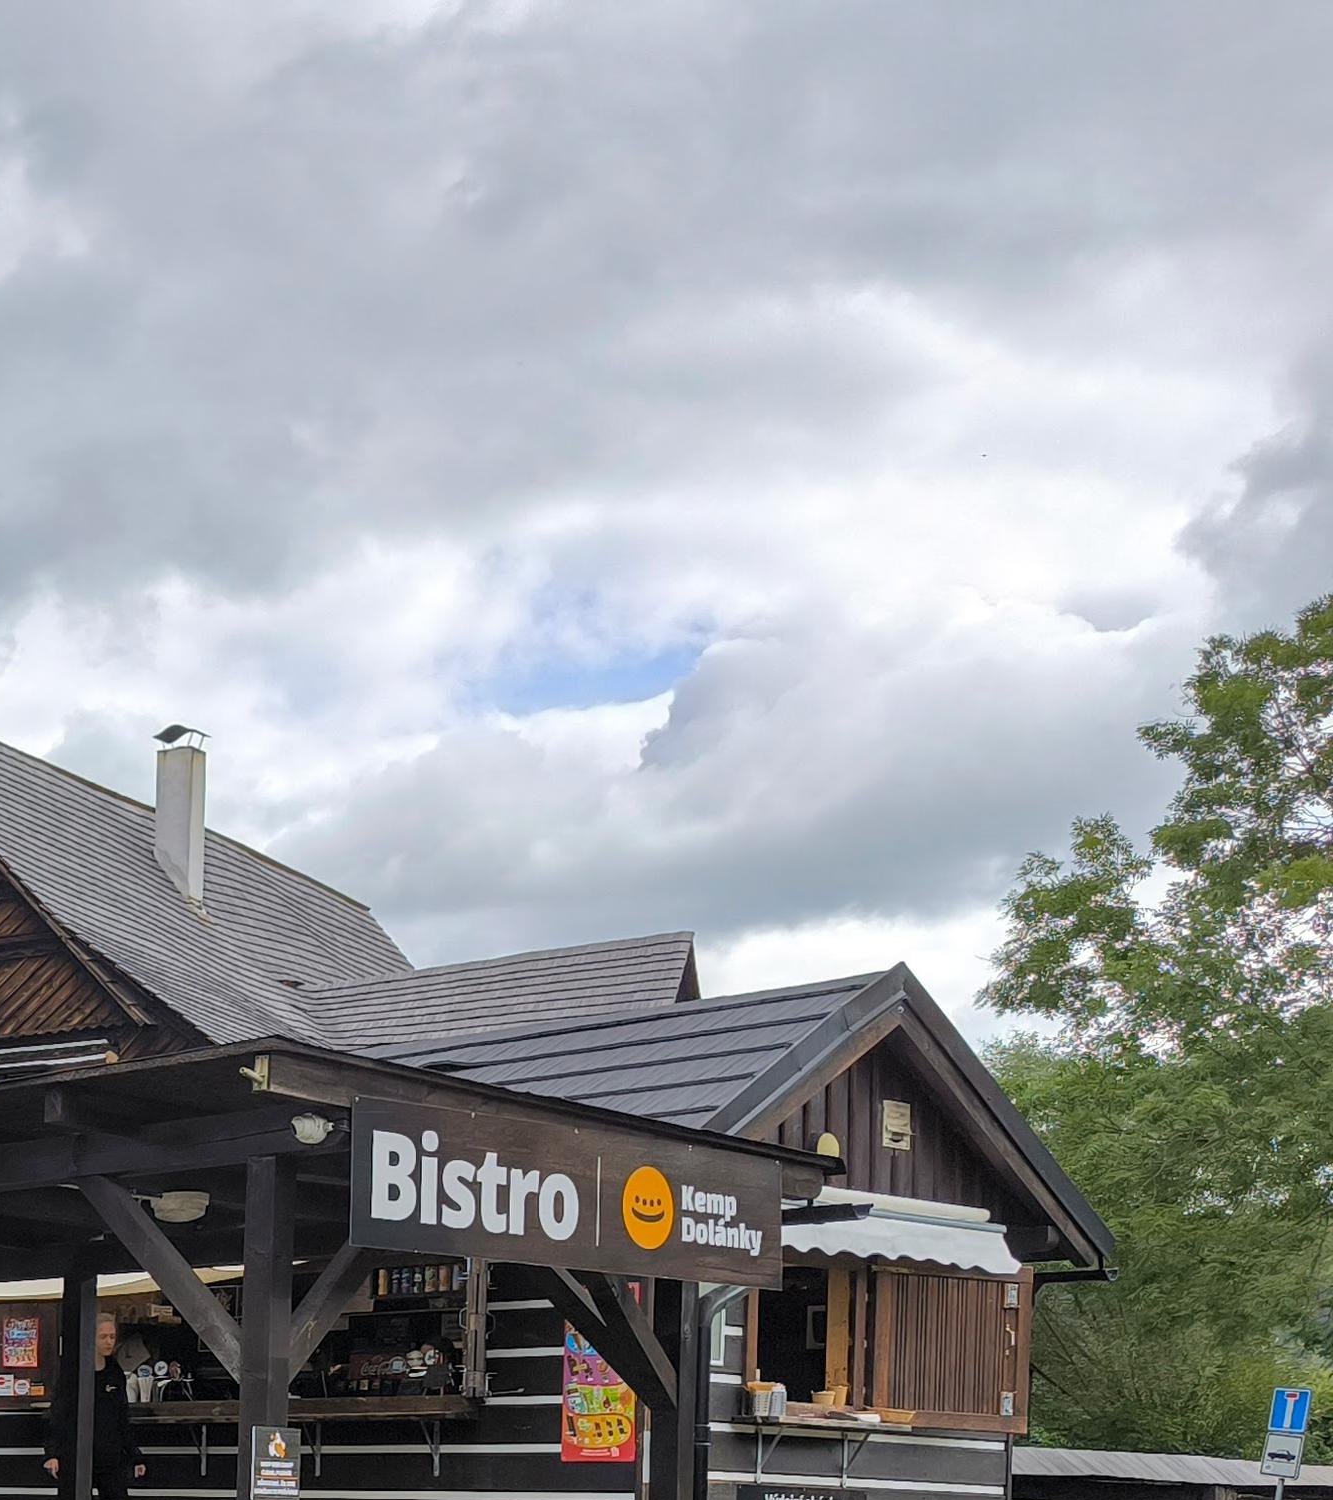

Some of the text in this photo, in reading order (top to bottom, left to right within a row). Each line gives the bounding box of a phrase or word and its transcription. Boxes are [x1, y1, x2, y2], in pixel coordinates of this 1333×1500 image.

[370, 1130, 580, 1241] Bistro
[681, 1185, 737, 1222] Kemp
[681, 1213, 763, 1256] Dolánky
